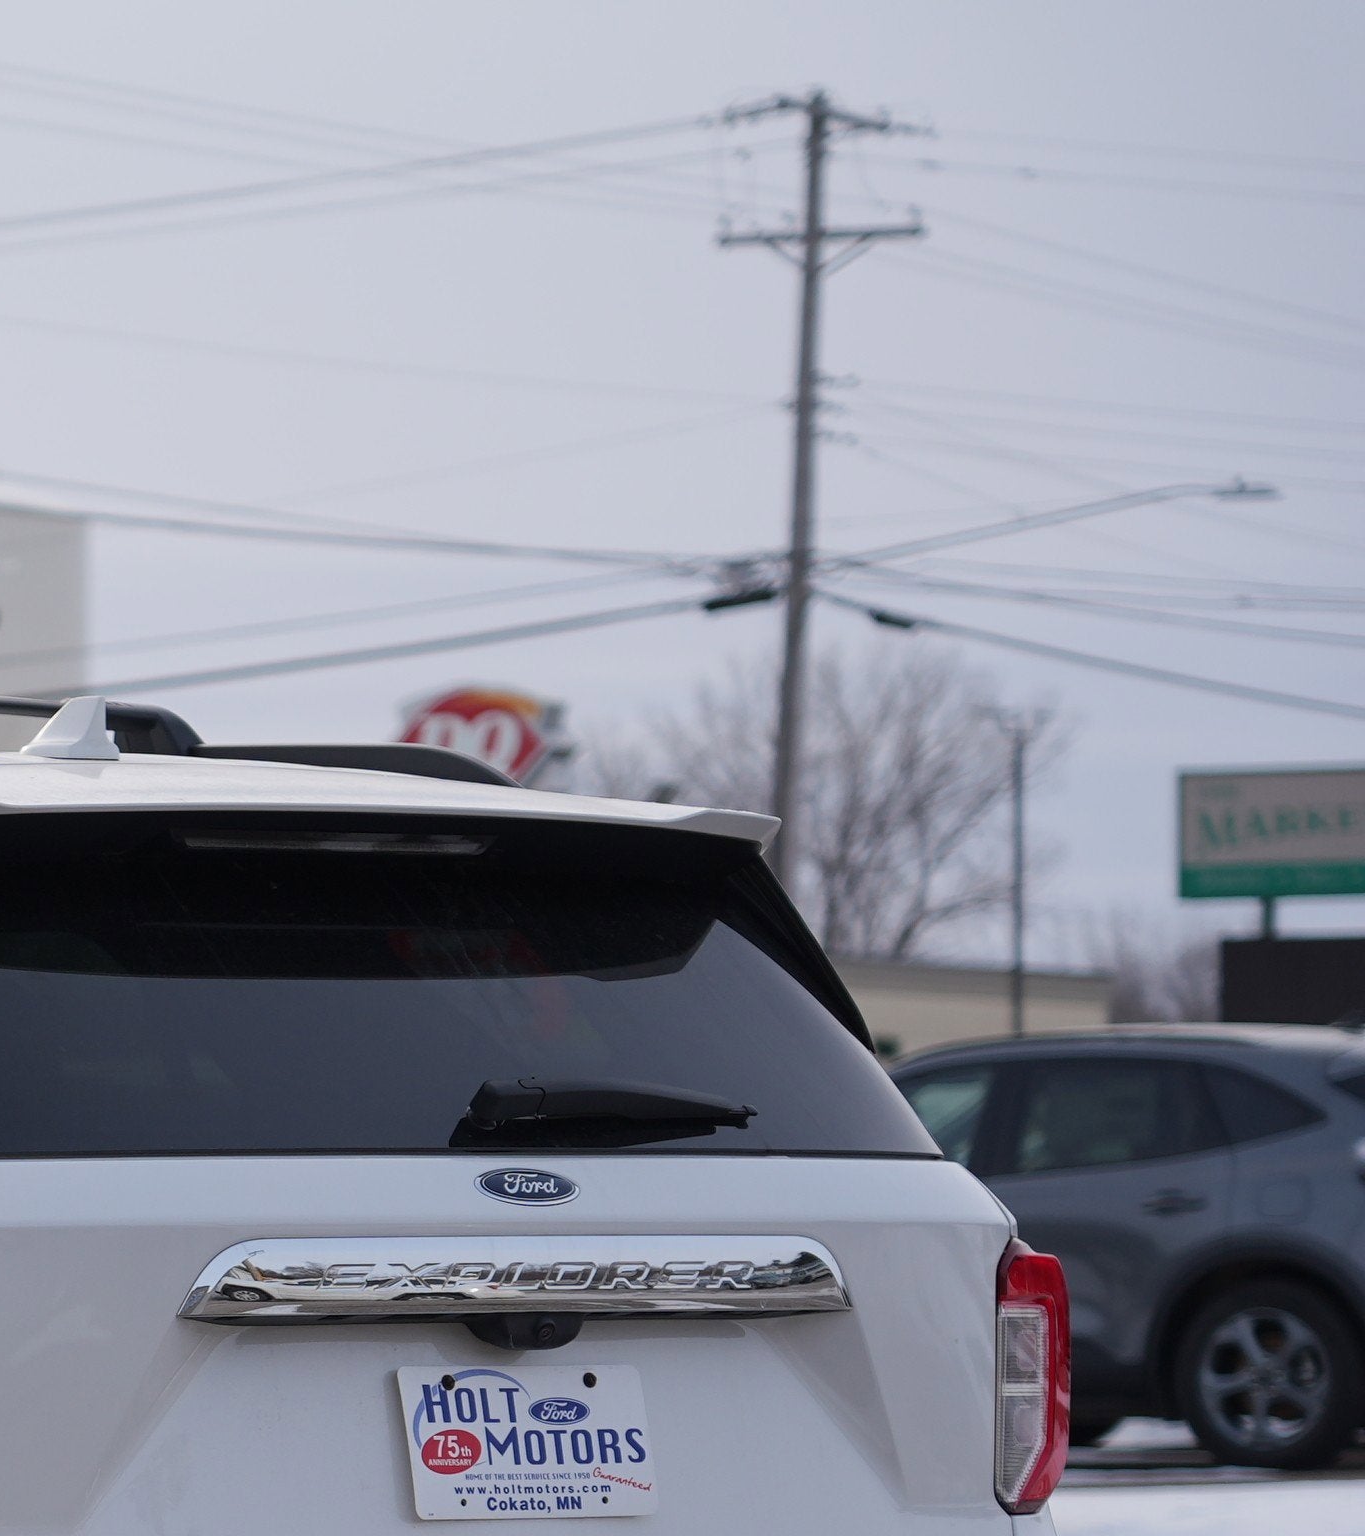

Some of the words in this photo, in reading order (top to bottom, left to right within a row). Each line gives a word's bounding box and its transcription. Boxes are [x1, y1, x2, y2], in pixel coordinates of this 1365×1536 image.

[504, 1172, 559, 1194] Ford
[316, 1261, 757, 1291] EXPLORER
[422, 1384, 520, 1423] HOLT
[433, 1435, 472, 1458] 75th
[485, 1426, 646, 1466] MOTORS
[429, 1458, 472, 1467] ANNIVERSARY
[465, 1473, 483, 1481] HOME
[484, 1473, 493, 1481] OF
[494, 1473, 506, 1481] THE
[507, 1473, 522, 1481] BEST
[524, 1472, 550, 1480] SERVICE
[552, 1472, 572, 1480] SINCE
[574, 1472, 591, 1480] 1950
[592, 1466, 652, 1492] Guaranteed
[454, 1483, 612, 1495] www.holtmotors.com
[486, 1496, 552, 1513] Cokato,
[556, 1495, 583, 1510] MN
